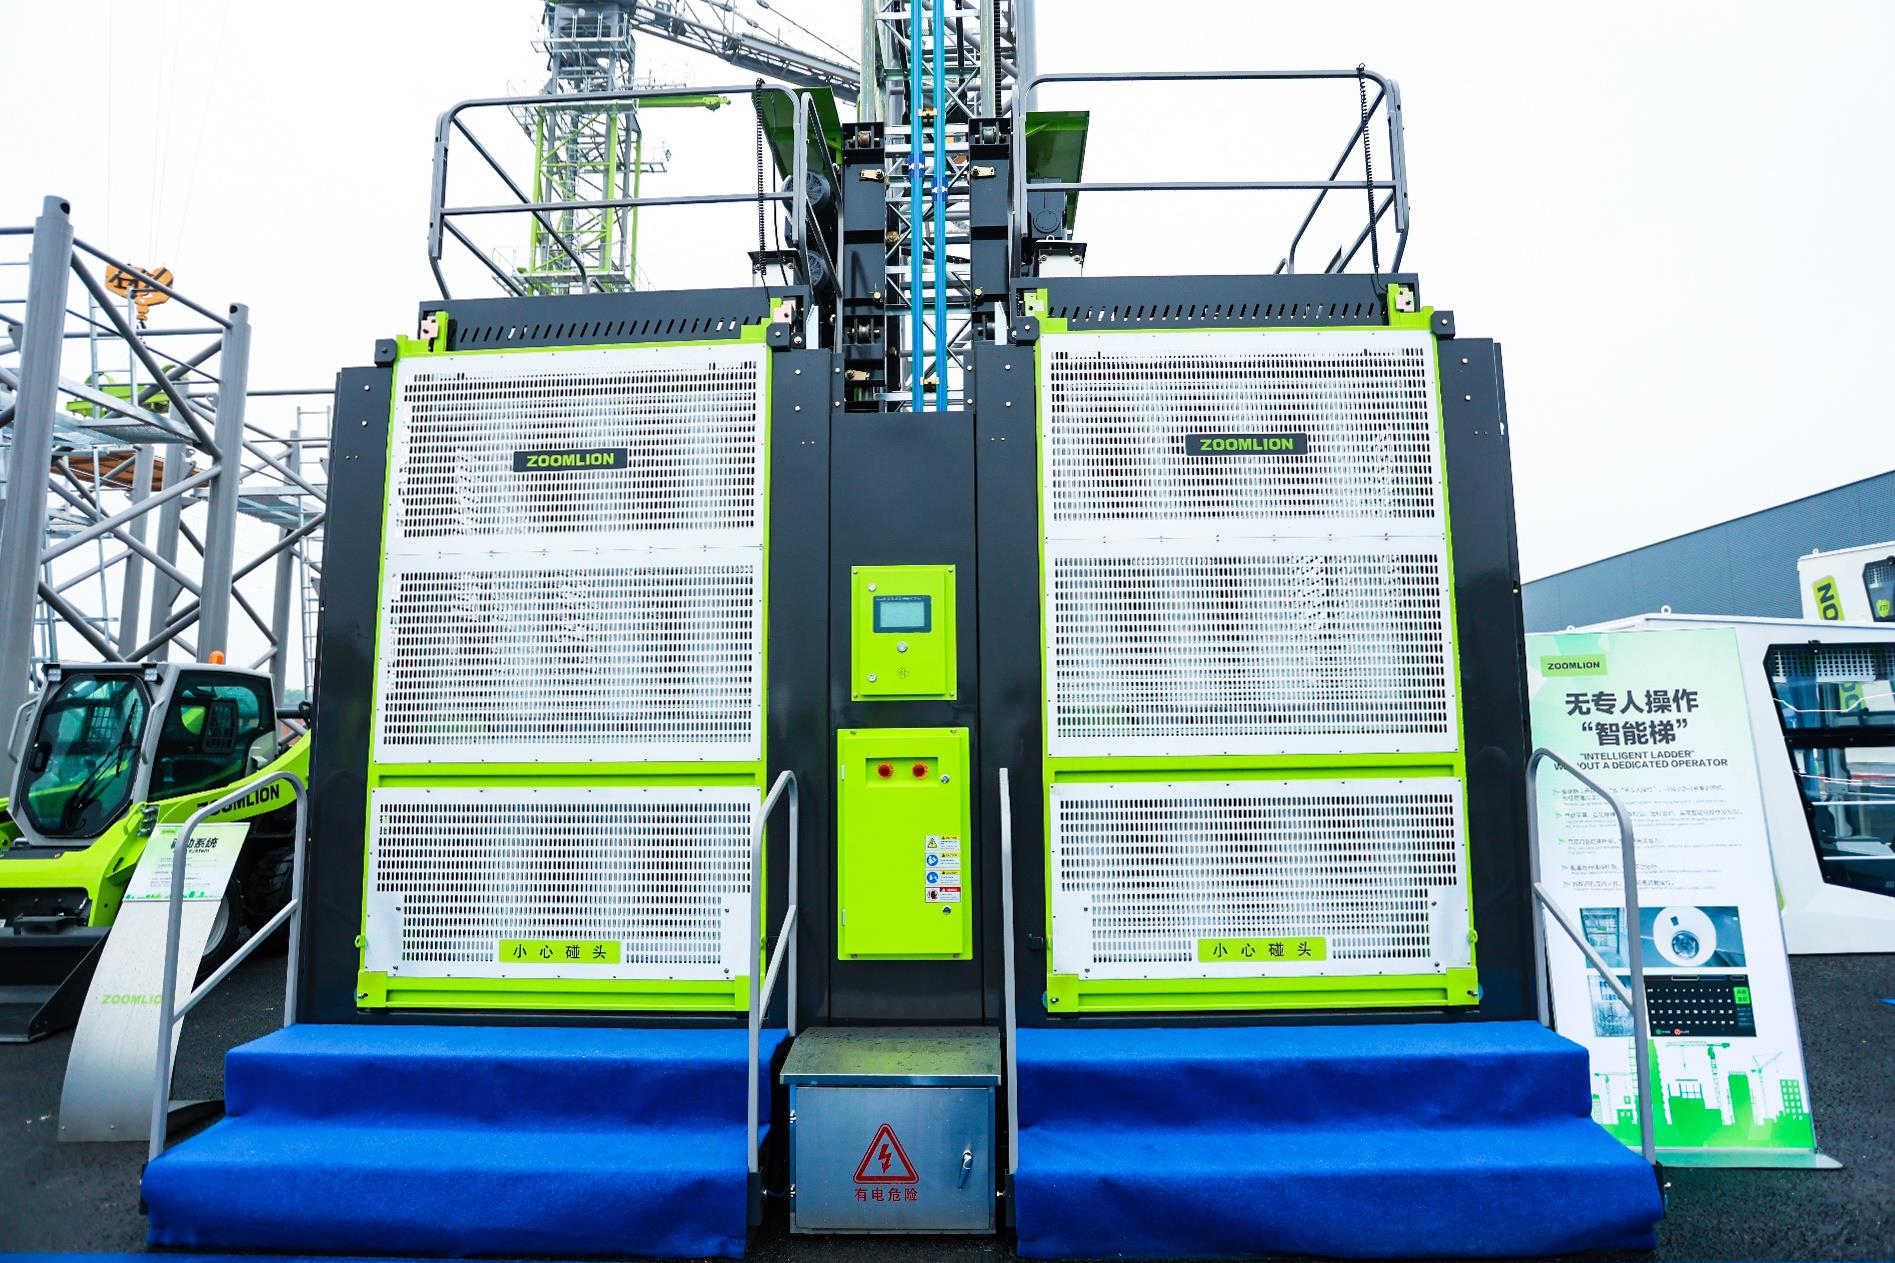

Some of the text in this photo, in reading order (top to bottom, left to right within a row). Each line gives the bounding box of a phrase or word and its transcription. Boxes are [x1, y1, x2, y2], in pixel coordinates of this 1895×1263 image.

[1200, 438, 1294, 451] ZOOMLION
[526, 453, 615, 467] ZOOMLION
[1547, 661, 1600, 670] ZOOMLION
[1565, 689, 1699, 716] 无专人操作
[1582, 718, 1688, 746] “智能梯”
[1603, 762, 1610, 770] A
[1612, 760, 1669, 769] DEDICATED
[1671, 758, 1728, 768] OPERATOR
[513, 944, 607, 959] 小心碰头
[1213, 941, 1312, 958] 小心碰头
[102, 994, 163, 1005] ZOOMLIO
[854, 1187, 918, 1202] 有电危险
